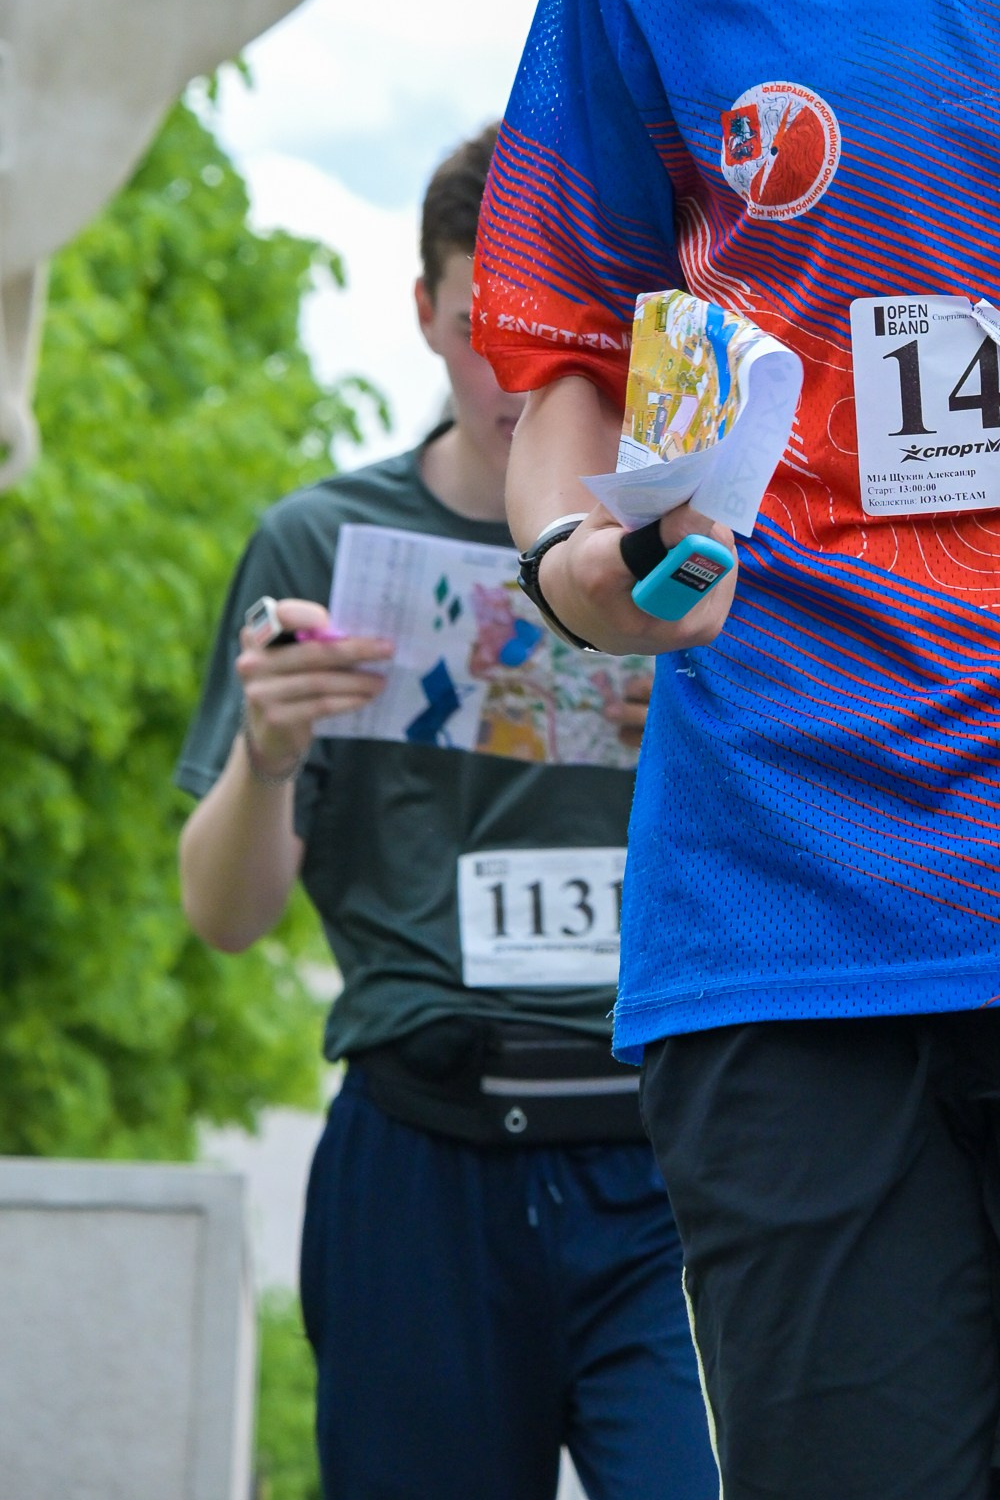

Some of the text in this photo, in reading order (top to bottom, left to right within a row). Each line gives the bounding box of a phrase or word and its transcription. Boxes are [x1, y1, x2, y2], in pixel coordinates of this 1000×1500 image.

[762, 85, 815, 102] ФЕДЕРАЦИЯ
[814, 101, 837, 166] СПОРТИВНОГО
[887, 304, 928, 319] OPEN
[888, 320, 930, 336] BAND
[889, 472, 924, 484] Щукин
[926, 468, 977, 480] Александр
[899, 483, 937, 493] 13:00:00
[487, 878, 624, 939] 1131
